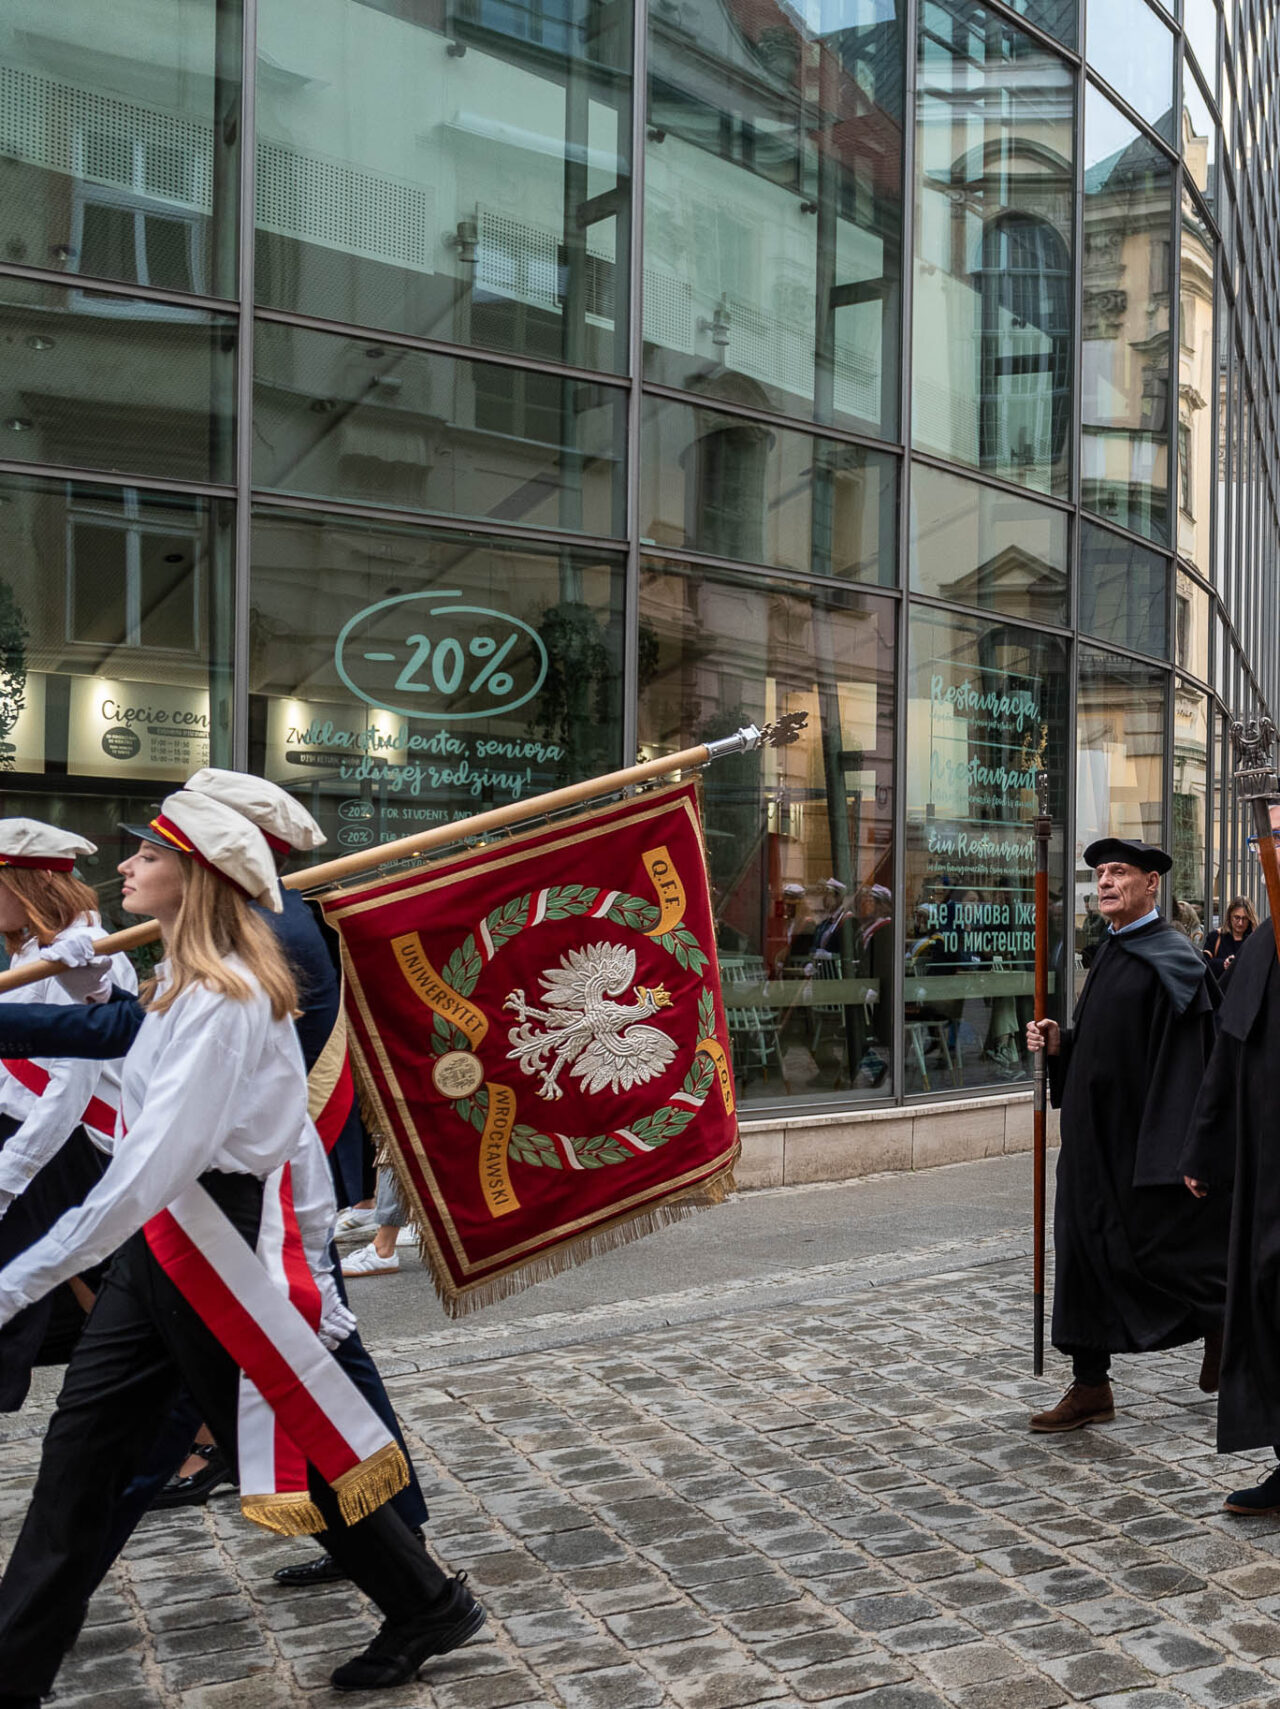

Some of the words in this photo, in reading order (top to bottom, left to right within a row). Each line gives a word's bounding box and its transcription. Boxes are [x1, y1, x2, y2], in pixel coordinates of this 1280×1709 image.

[364, 632, 517, 696] -20%
[102, 700, 169, 728] Cięcie
[930, 673, 1041, 733] Restauracja,
[302, 718, 354, 748] dla
[360, 723, 470, 758] studenta,
[475, 738, 565, 764] seniora
[340, 759, 353, 780] i
[428, 760, 532, 799] rodziny!
[342, 807, 371, 818] -20%
[380, 807, 399, 819] FOR
[402, 808, 449, 821] STUDENTS
[341, 831, 369, 843] -20%
[928, 827, 956, 856] Ein
[927, 903, 948, 930] де
[952, 903, 1010, 930] домова
[943, 931, 958, 952] то
[401, 943, 484, 1035] UNIWERSYTET
[482, 1089, 512, 1206] WROCŁAWSKI
